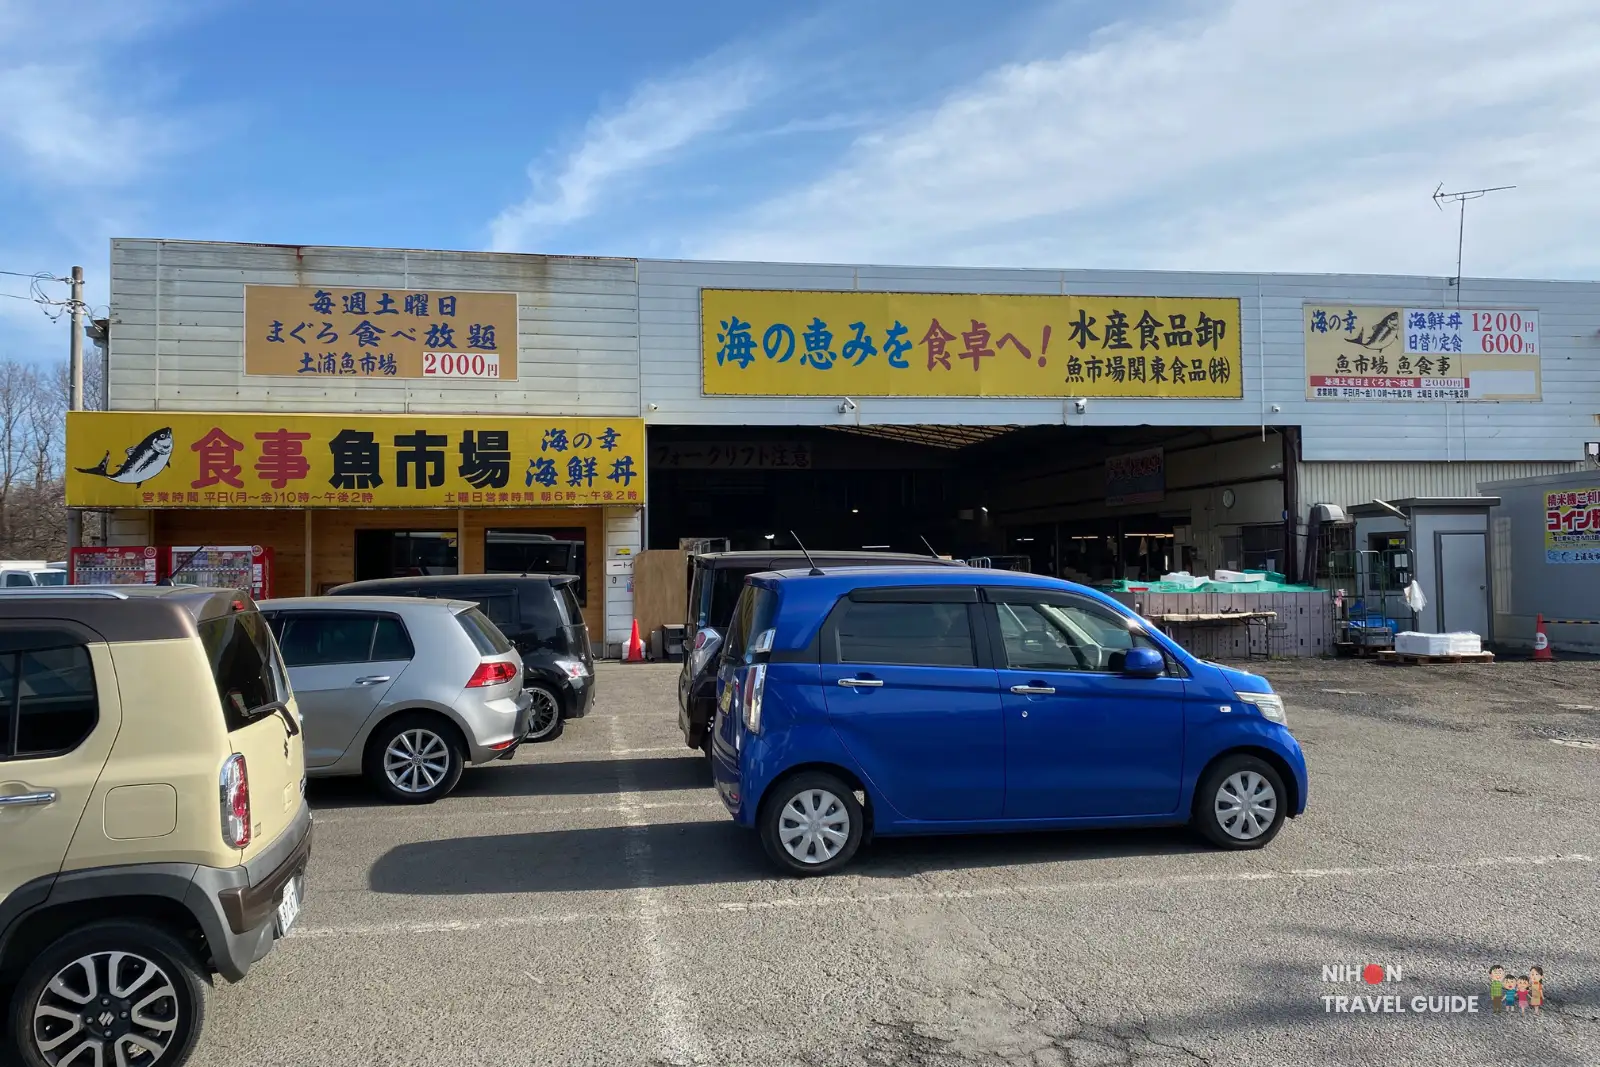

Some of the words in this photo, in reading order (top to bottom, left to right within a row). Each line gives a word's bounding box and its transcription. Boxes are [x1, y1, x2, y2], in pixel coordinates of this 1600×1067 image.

[309, 290, 457, 317] 毎週土曜日
[1068, 309, 1226, 351] 水産食品卸
[1310, 310, 1357, 333] 海の幸
[1408, 311, 1463, 330] 海鮮丼
[1472, 312, 1534, 332] 1200円
[266, 320, 497, 350] まぐろ食べ放題
[1408, 333, 1463, 352] 日替り定食
[1481, 333, 1535, 353] 600円
[297, 352, 398, 375] 土浦魚市場
[424, 354, 498, 377] 2000円
[1334, 354, 1388, 375] 魚市場
[1396, 355, 1451, 376] 魚食事
[1425, 379, 1460, 387] 2000円
[541, 427, 621, 452] 海の幸
[190, 427, 312, 490] 食事
[328, 429, 511, 490] 魚市場
[657, 444, 810, 468] フォークリフト注意
[525, 455, 637, 488] 海鮮丼
[142, 491, 199, 503] 営業時間
[444, 491, 534, 503] 土曜日営業時間
